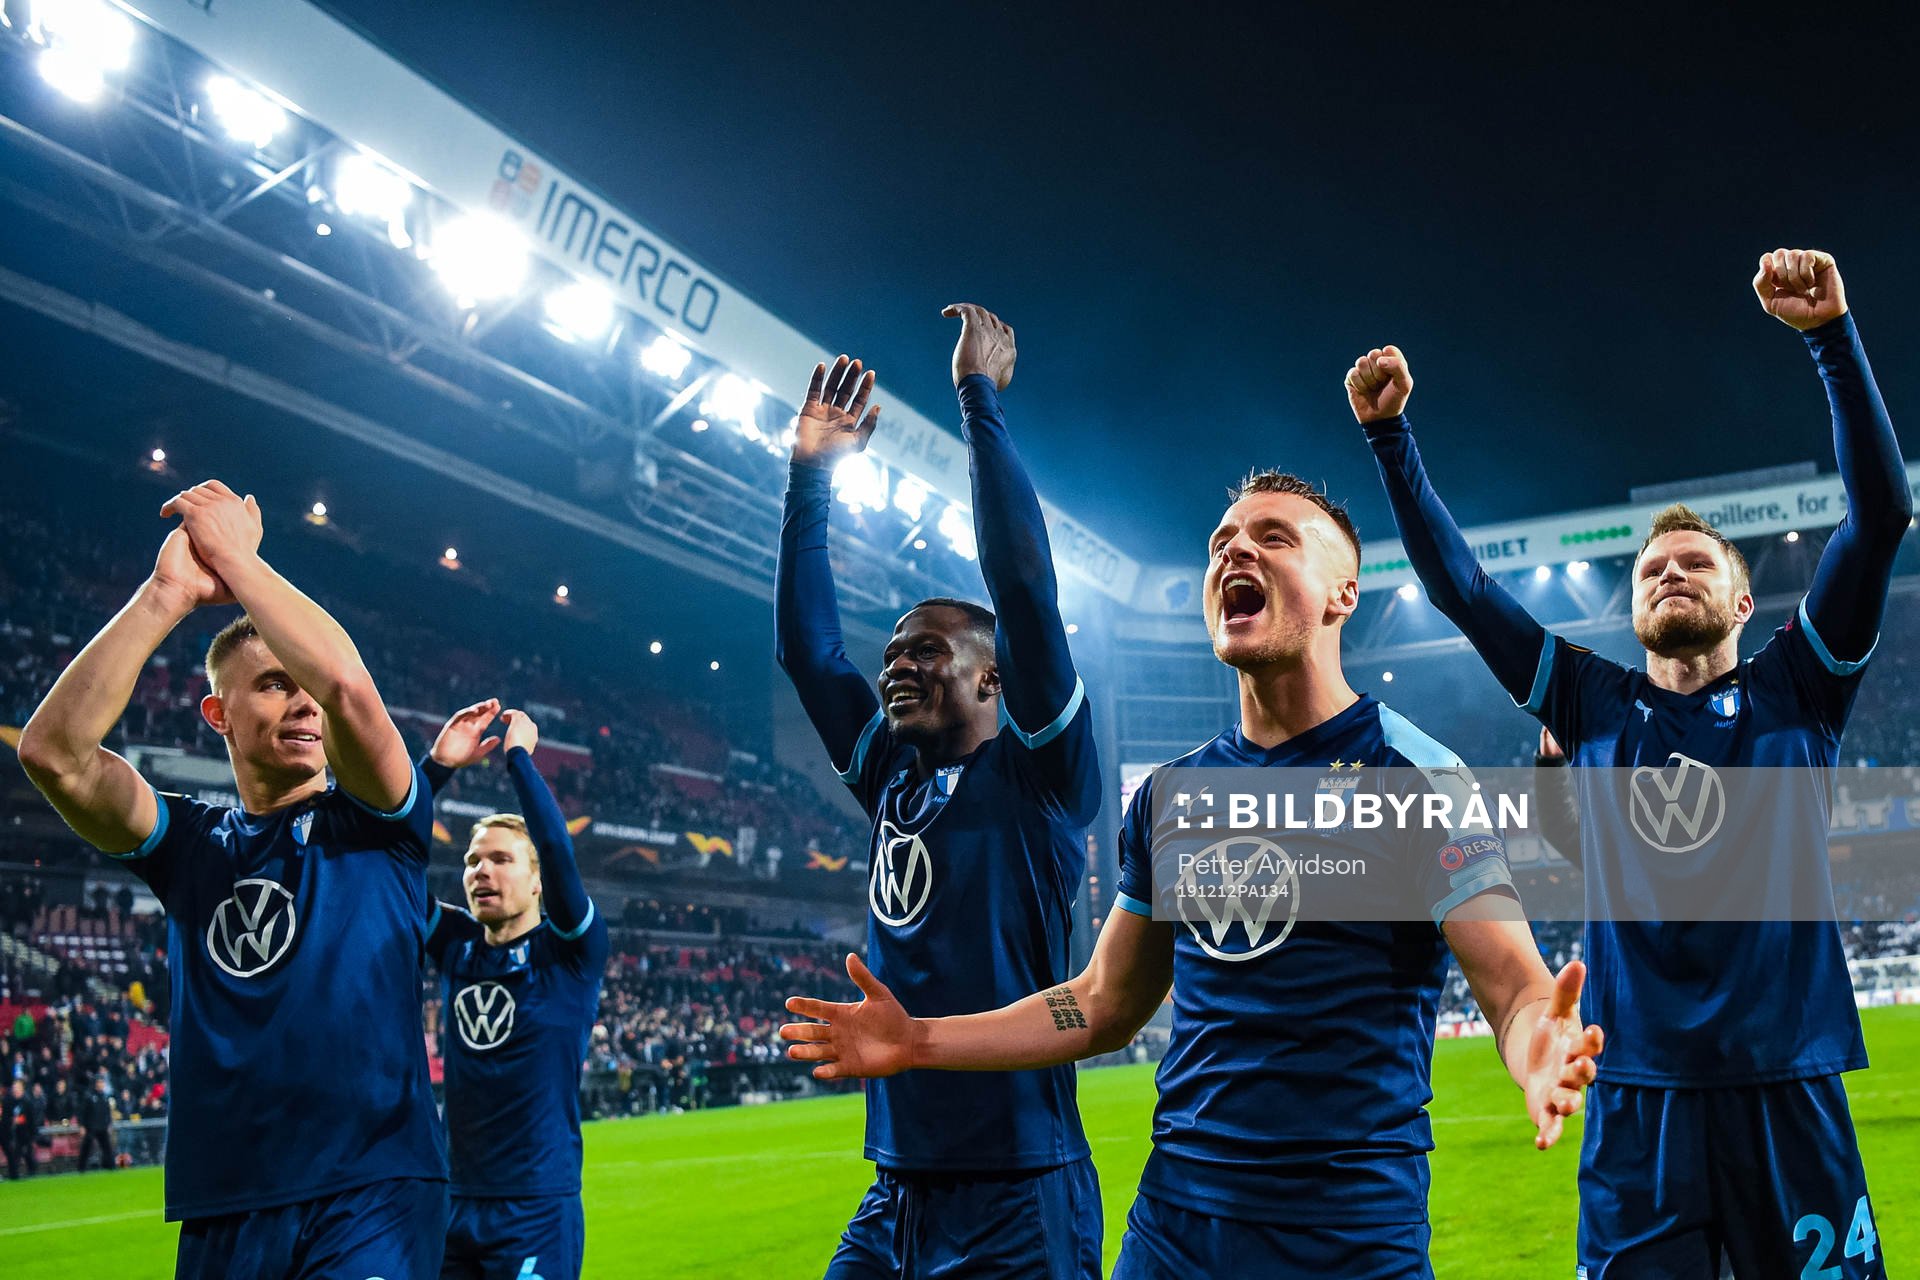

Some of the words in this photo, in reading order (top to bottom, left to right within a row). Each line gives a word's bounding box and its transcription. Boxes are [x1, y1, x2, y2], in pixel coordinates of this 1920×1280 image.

[537, 179, 720, 335] IMERCO
[1797, 491, 1828, 515] for
[1471, 536, 1528, 560] IBET
[1793, 1195, 1877, 1280] 24
